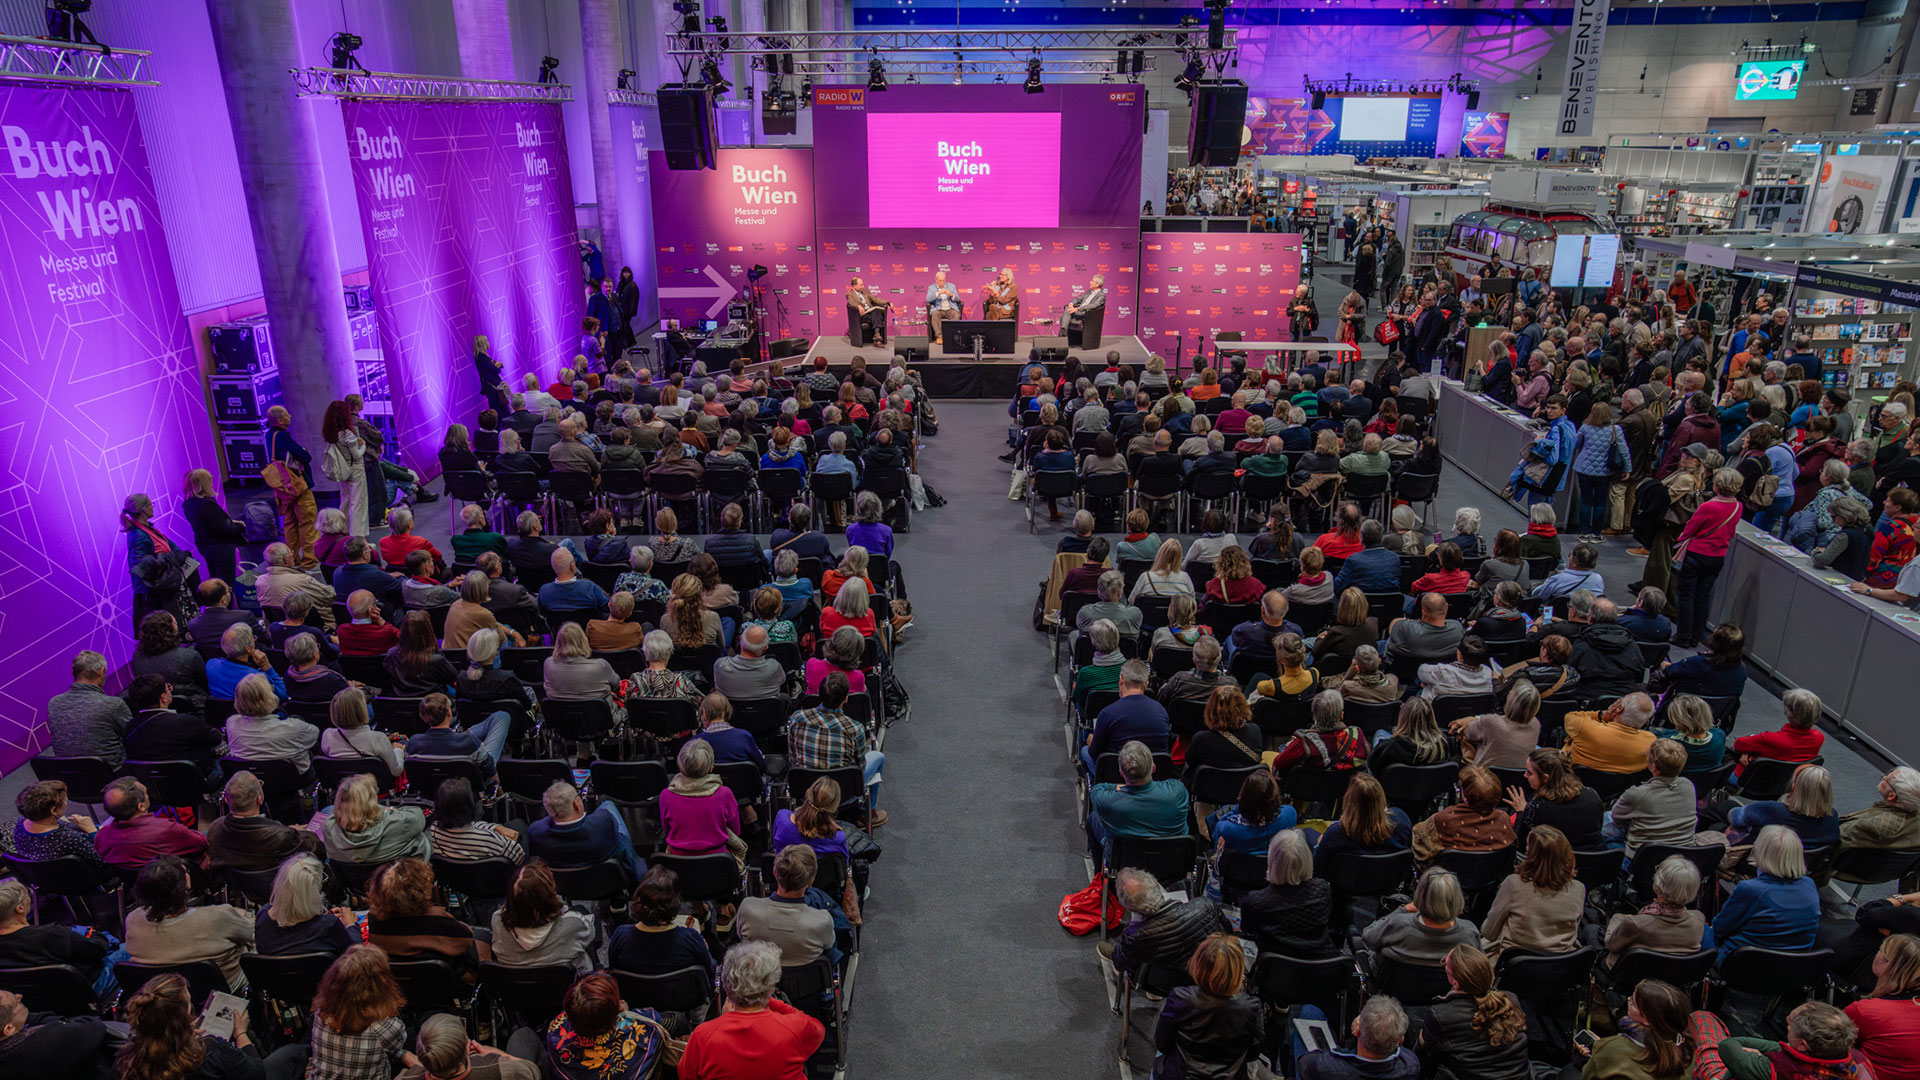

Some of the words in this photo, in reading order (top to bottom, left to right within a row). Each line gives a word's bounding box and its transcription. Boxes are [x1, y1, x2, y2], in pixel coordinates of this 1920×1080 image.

[1583, 12, 1604, 114] PUBLISHING
[850, 92, 862, 101] W
[516, 122, 541, 148] Buch
[632, 120, 646, 139] Buch
[2, 126, 114, 179] Buch
[356, 126, 402, 160] Buch
[938, 141, 982, 157] Buch
[523, 151, 548, 177] Wien
[732, 164, 787, 183] Buch
[944, 159, 990, 175] Wien
[369, 166, 415, 200] Wien
[741, 186, 798, 204] Wien
[36, 186, 143, 240] Wien
[371, 208, 391, 222] Messe
[391, 204, 404, 219] und
[374, 224, 399, 240] Festival
[40, 254, 88, 275] Messe
[90, 245, 118, 268] und
[48, 276, 105, 303] Festival
[1822, 278, 1839, 286] VERLAG
[1840, 280, 1850, 288] FÜR
[1850, 282, 1882, 294] NEUAUTOREN
